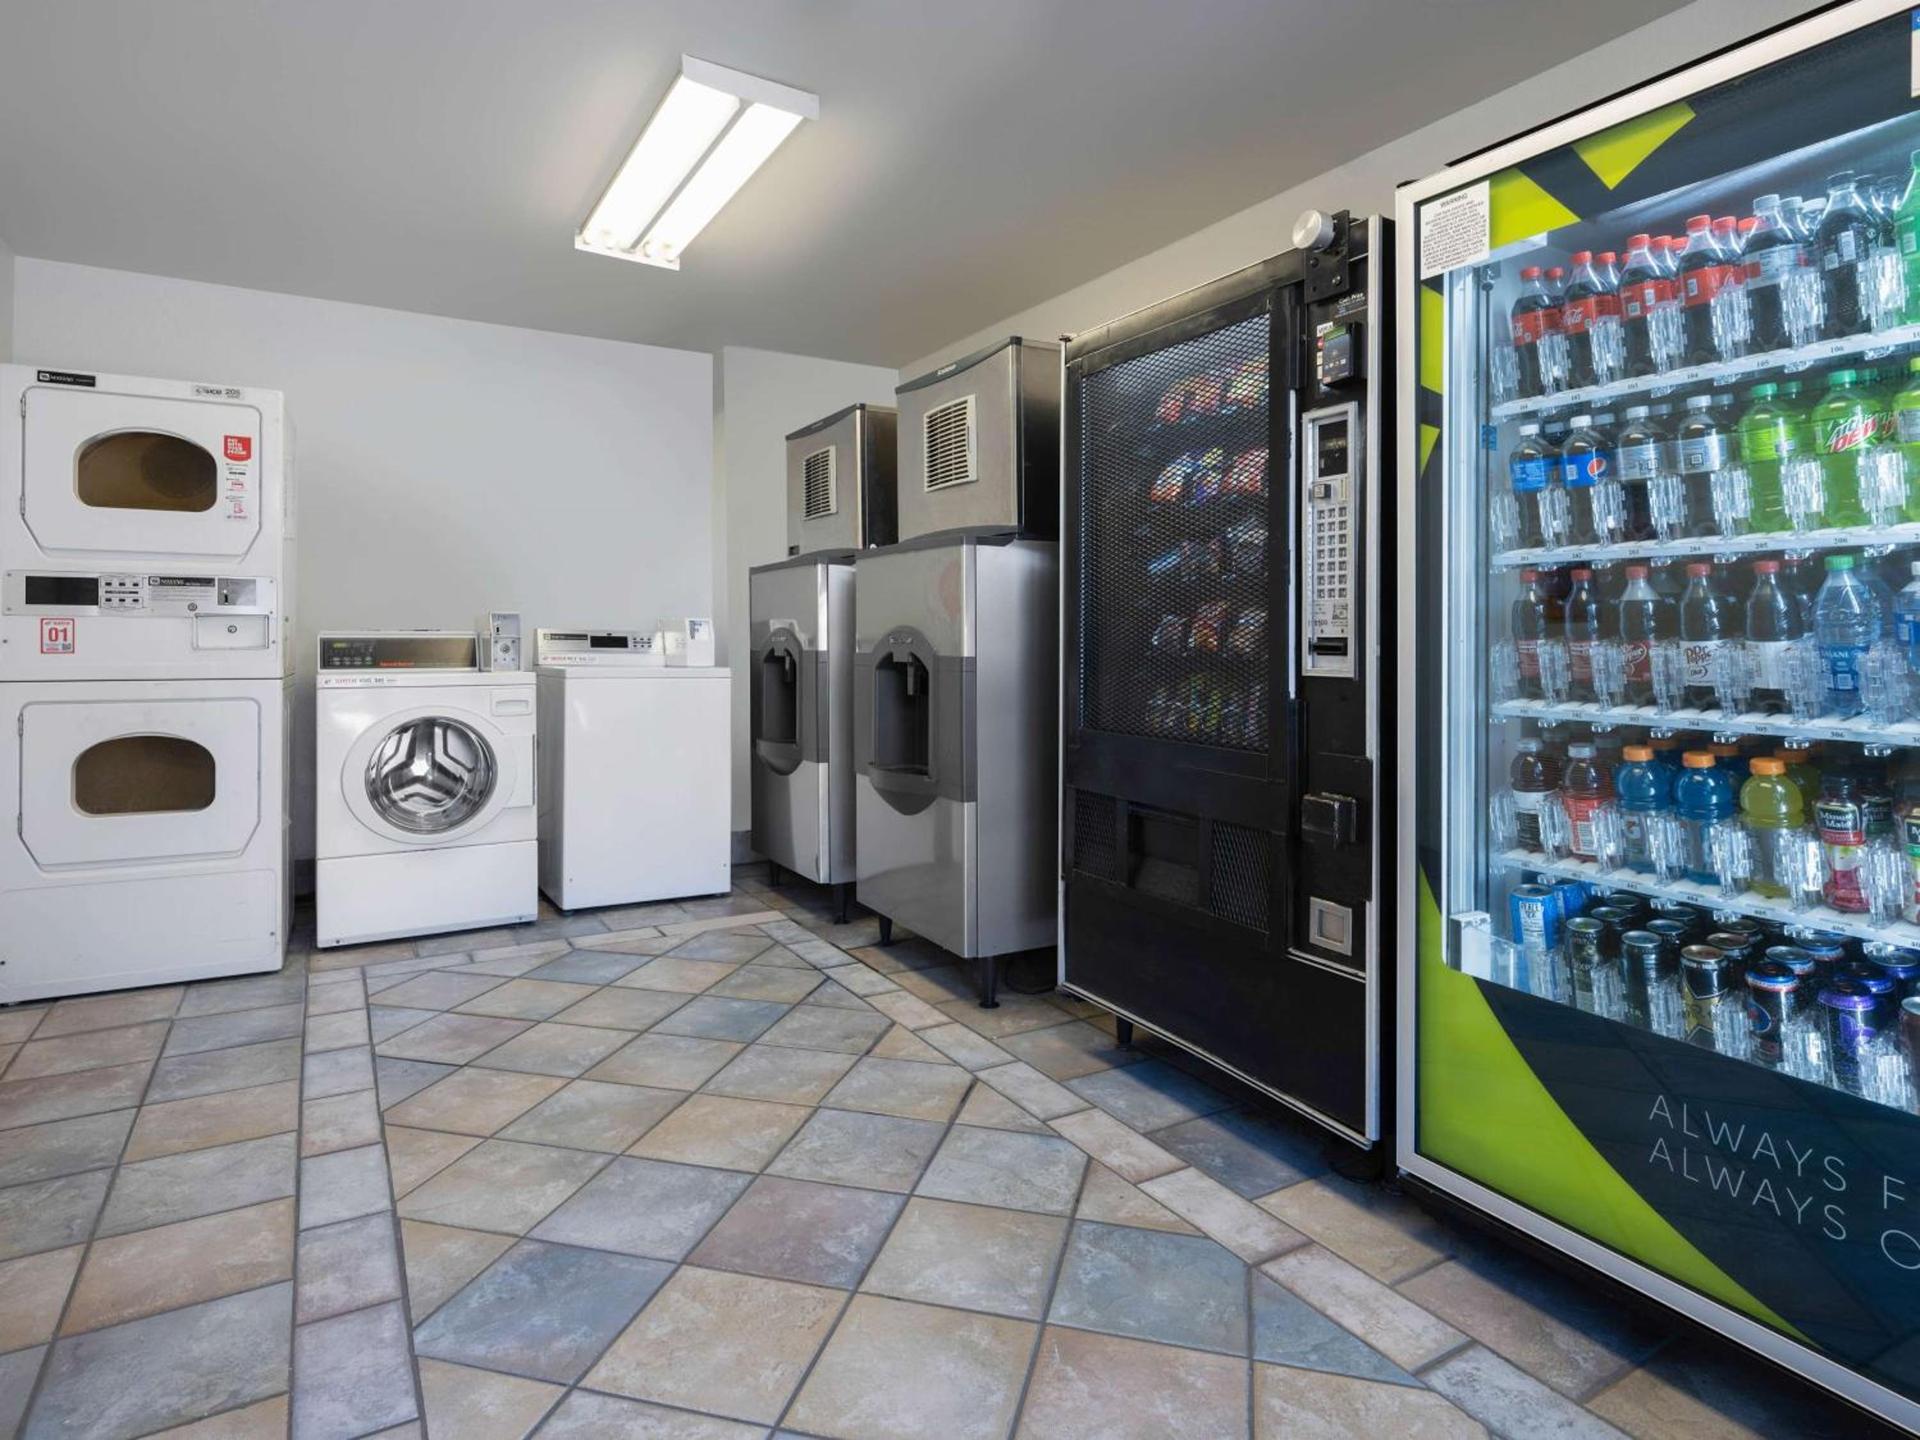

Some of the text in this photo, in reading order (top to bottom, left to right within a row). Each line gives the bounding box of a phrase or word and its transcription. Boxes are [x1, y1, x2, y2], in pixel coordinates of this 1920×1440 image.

[48, 627, 68, 642] 01
[1824, 819, 1853, 829] Maid
[1648, 1094, 1848, 1192] ALWAYS
[1648, 1137, 1848, 1241] ALWAYS
